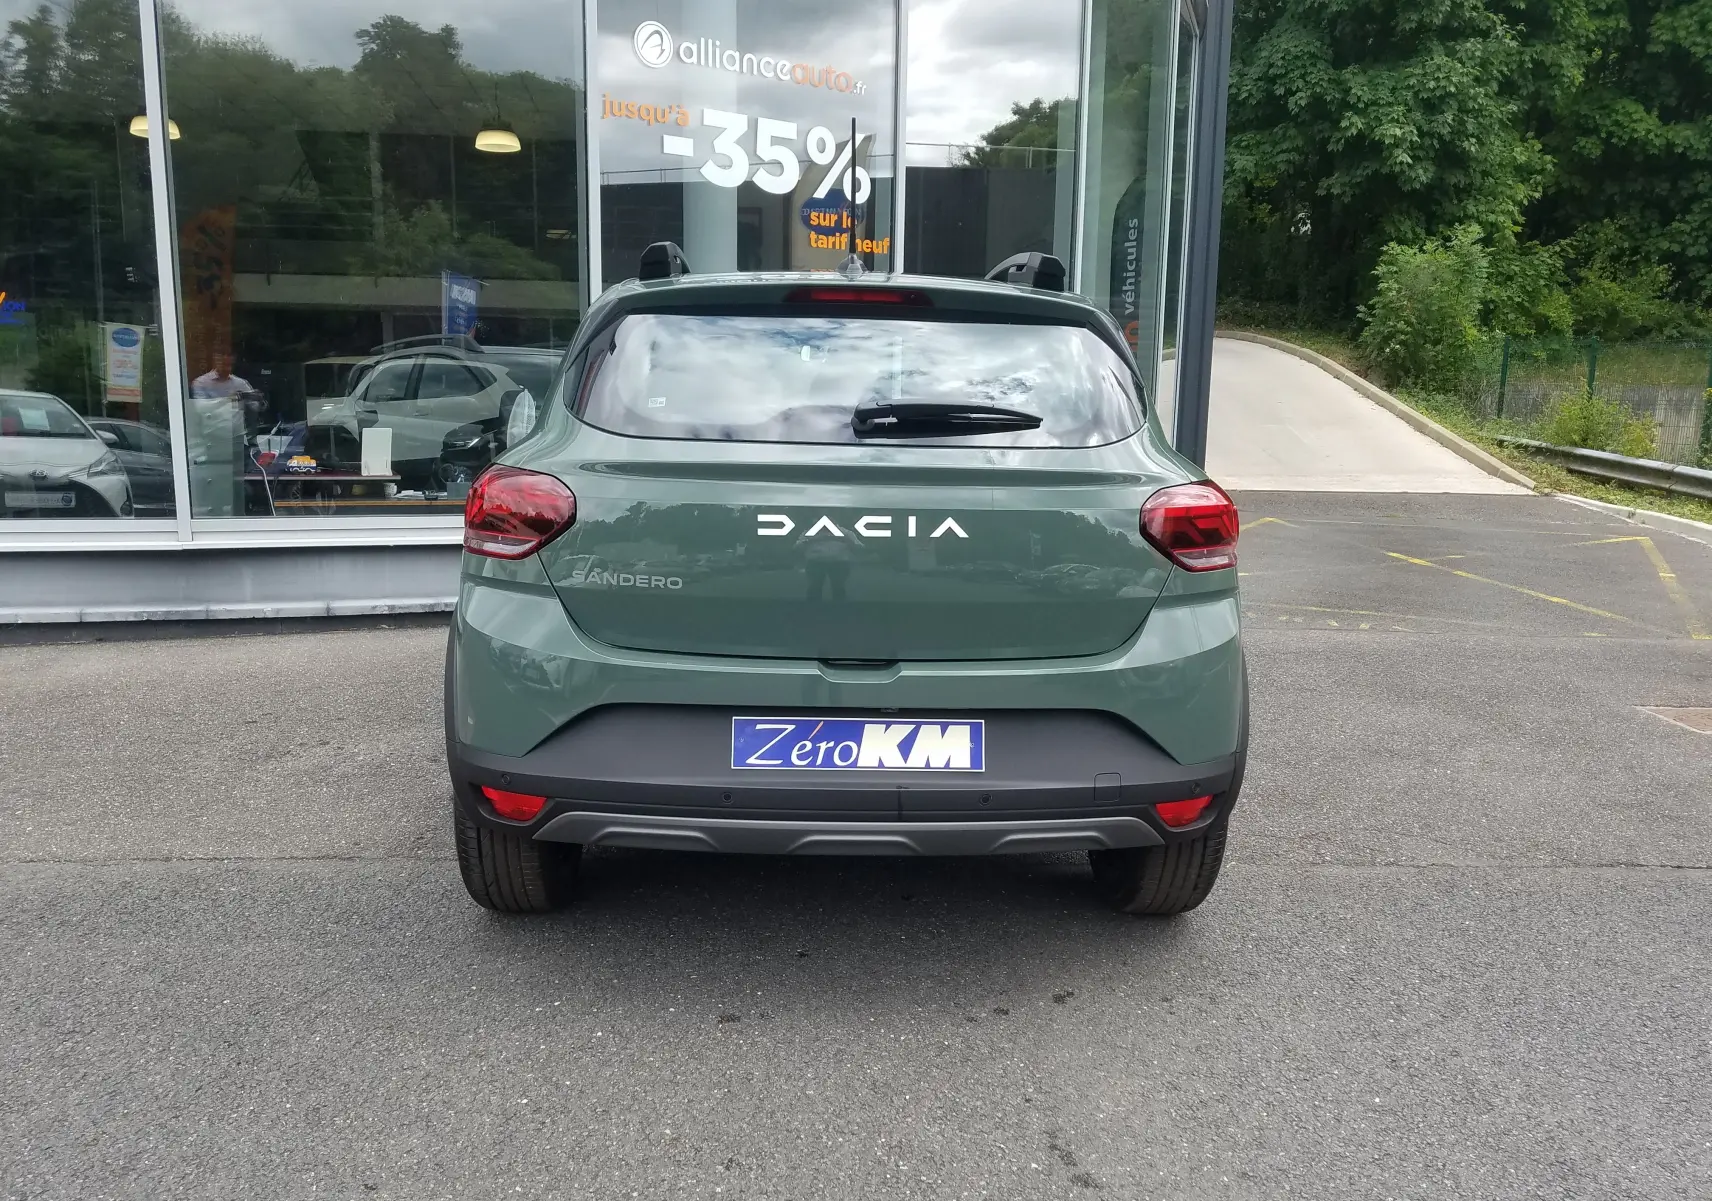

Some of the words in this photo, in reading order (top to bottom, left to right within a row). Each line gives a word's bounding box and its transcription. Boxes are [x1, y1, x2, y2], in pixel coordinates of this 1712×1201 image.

[601, 93, 690, 127] jusqu'à
[662, 107, 871, 205] -35%
[809, 211, 838, 227] sur
[809, 231, 848, 250] tarif
[855, 236, 890, 254] neuf
[1122, 218, 1139, 315] véhicules
[757, 514, 969, 538] DACIA
[572, 570, 683, 590] SANDERO
